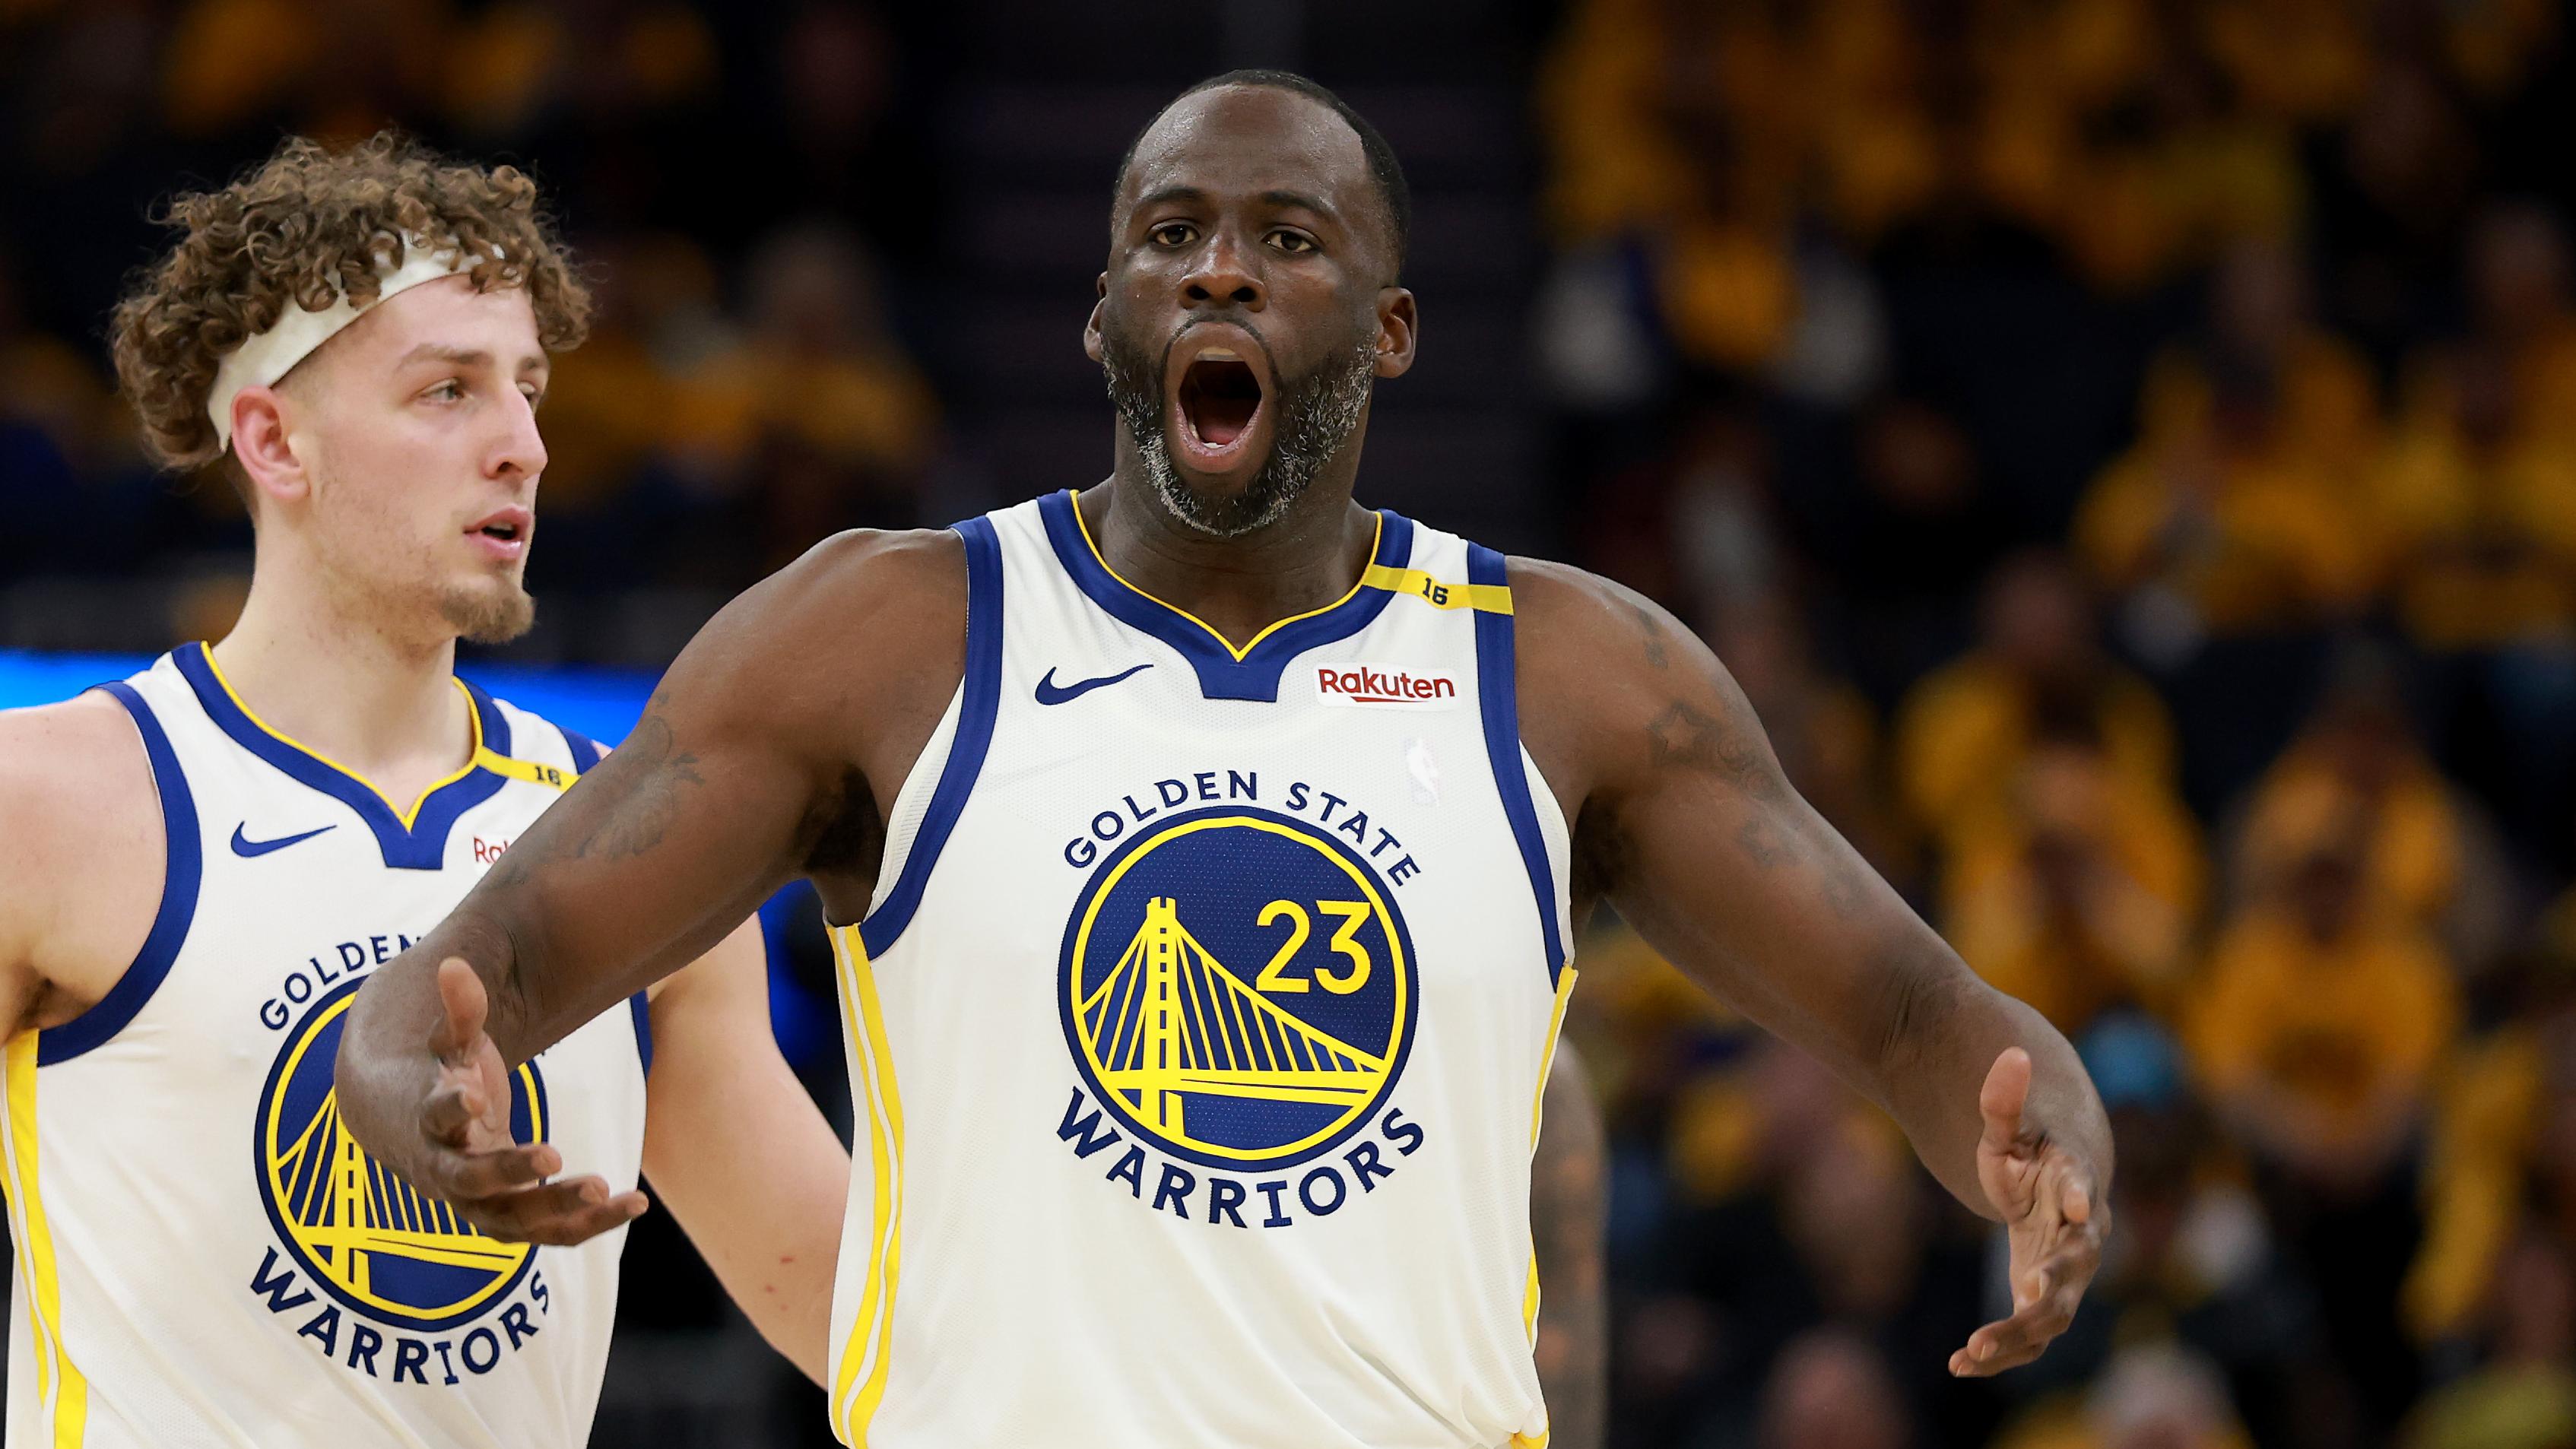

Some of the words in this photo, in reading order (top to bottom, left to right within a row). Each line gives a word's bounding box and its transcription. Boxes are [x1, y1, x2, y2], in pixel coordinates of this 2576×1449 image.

[1422, 578, 1448, 605] 16
[1318, 666, 1455, 699] Rakuten
[1064, 770, 1257, 868] GOLDEN
[1286, 782, 1421, 887] STATE
[1256, 899, 1371, 994] 23
[1056, 1086, 1424, 1229] WARRIORS
[250, 1246, 549, 1386] WARRIORS
